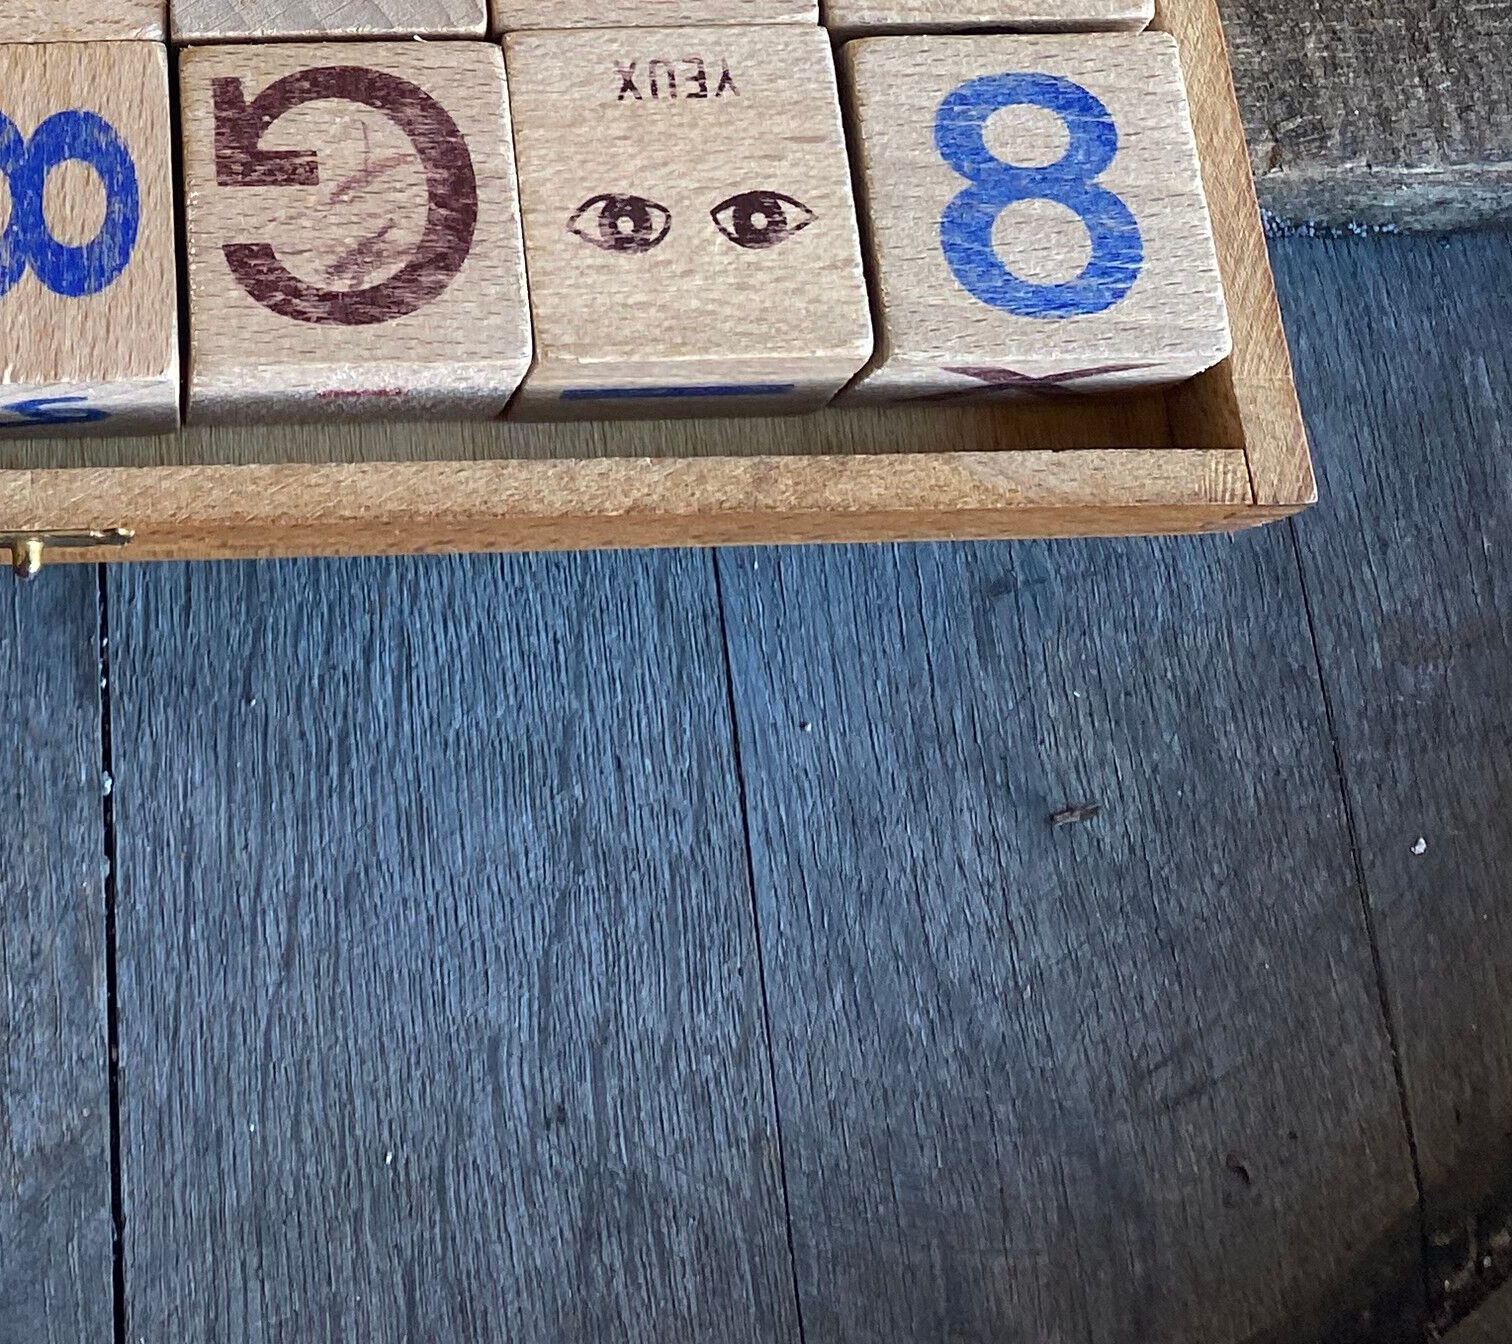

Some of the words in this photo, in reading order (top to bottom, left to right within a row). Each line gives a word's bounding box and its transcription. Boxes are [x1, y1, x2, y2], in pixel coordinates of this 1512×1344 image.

[211, 65, 478, 325] G
[614, 57, 740, 102] YEUX
[935, 73, 1144, 320] 8
